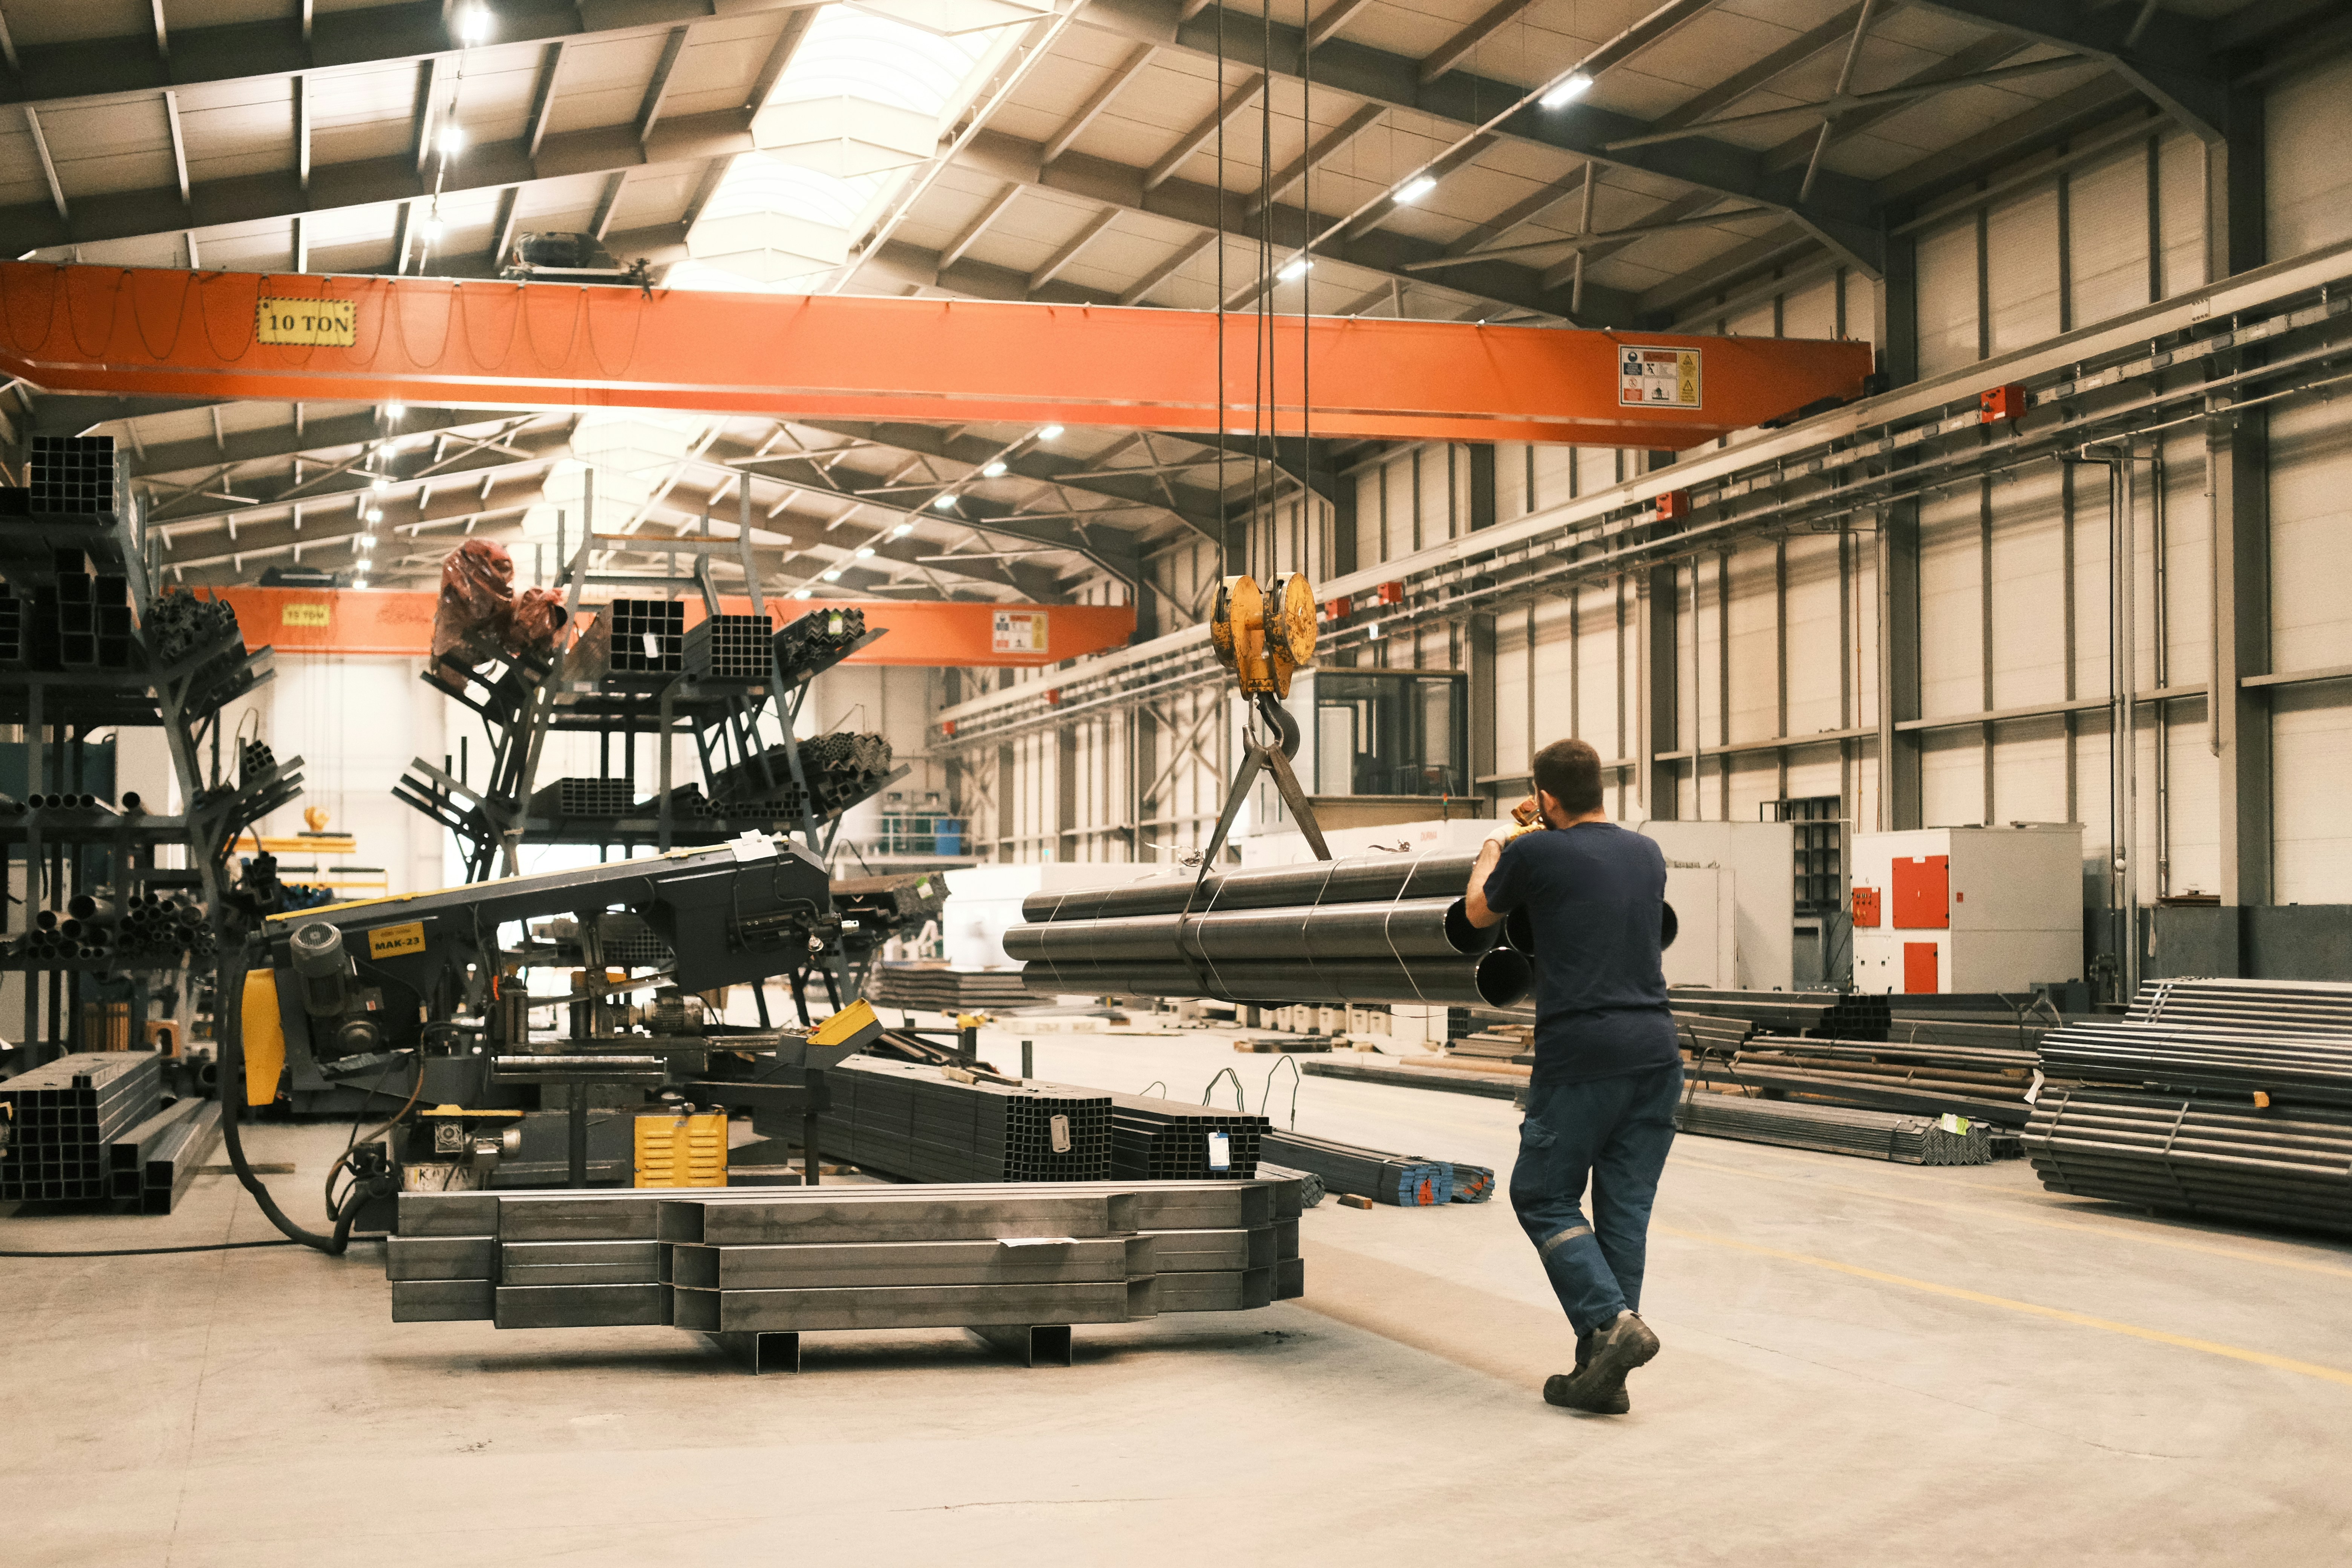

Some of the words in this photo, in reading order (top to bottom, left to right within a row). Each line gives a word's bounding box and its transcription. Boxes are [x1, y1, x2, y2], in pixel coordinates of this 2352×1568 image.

[269, 315, 295, 330] 10
[302, 316, 349, 332] TON
[303, 610, 324, 620] TON
[375, 937, 420, 950] MAK-23
